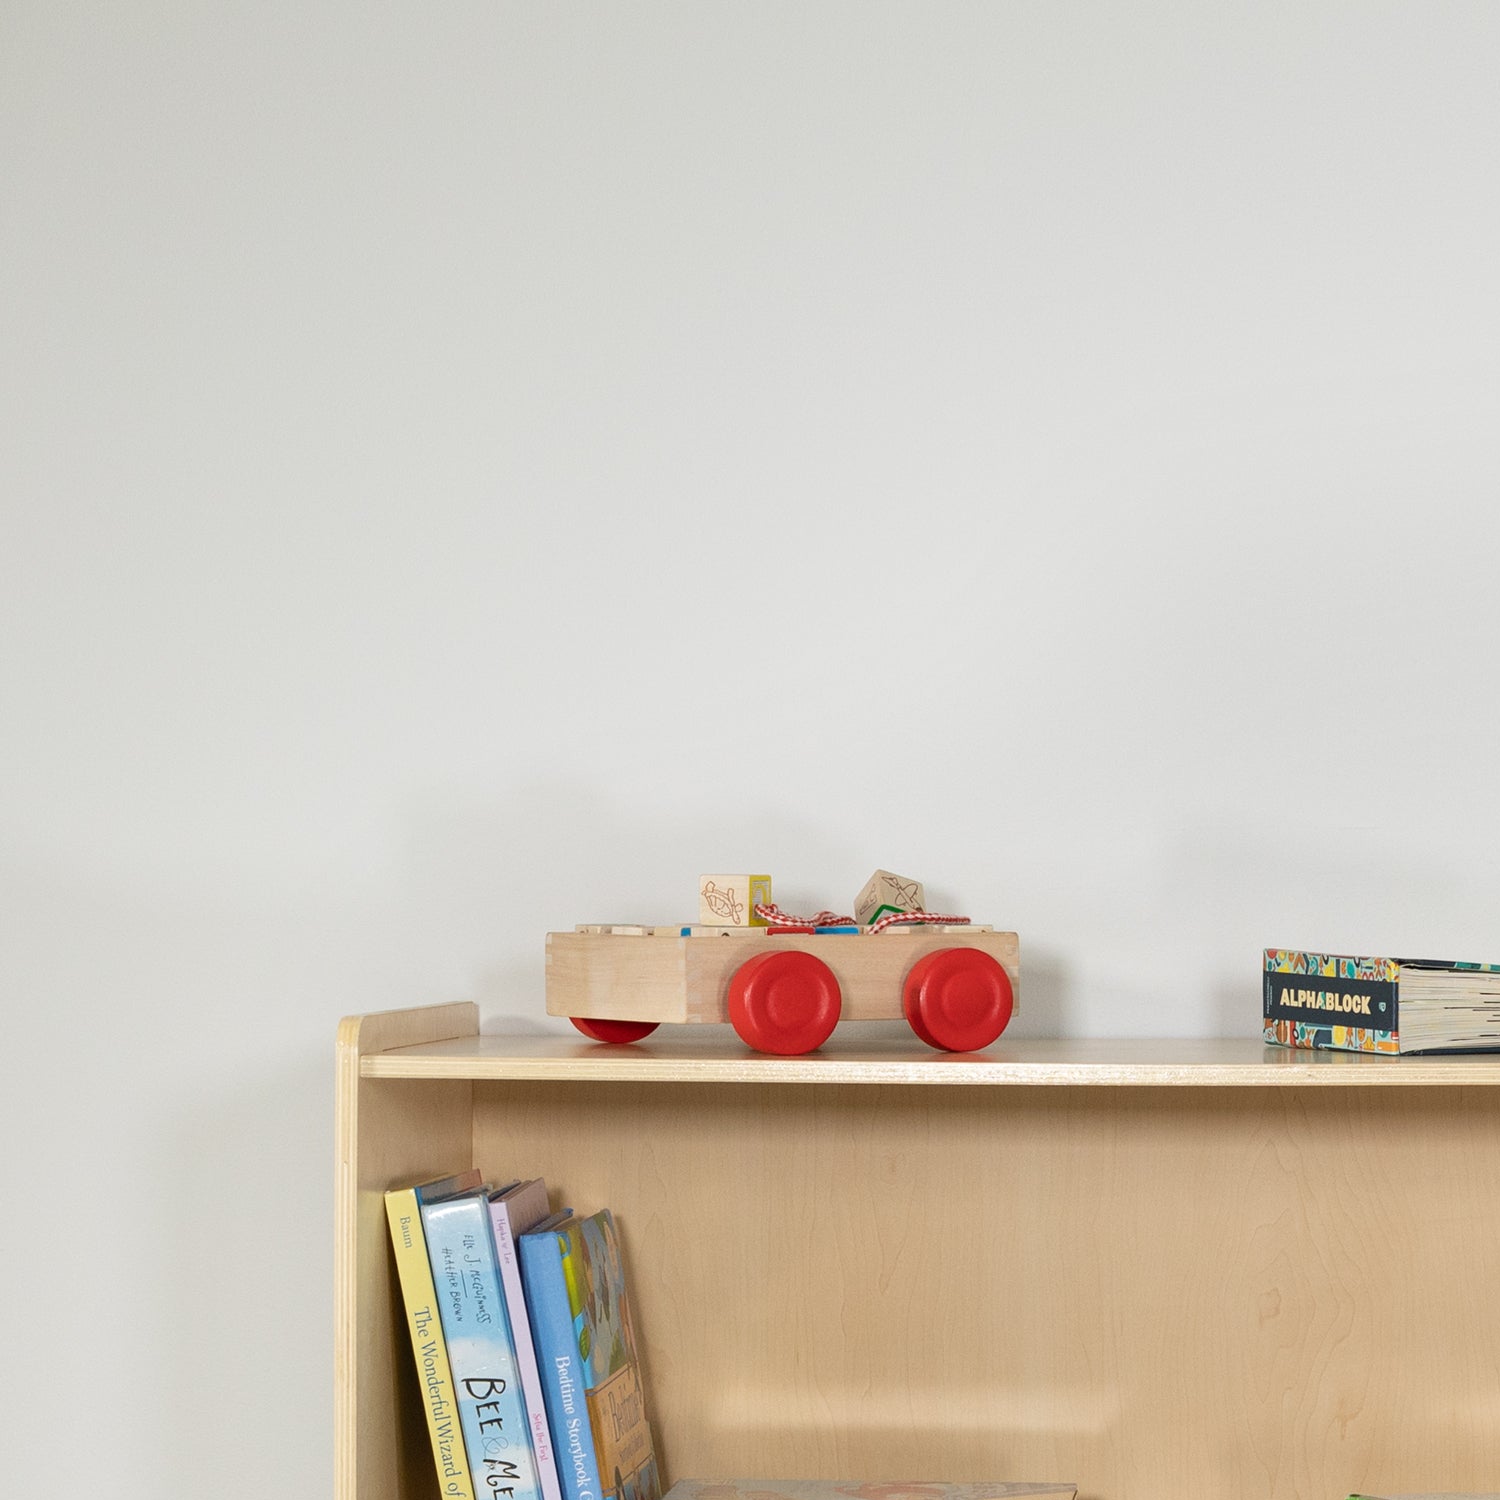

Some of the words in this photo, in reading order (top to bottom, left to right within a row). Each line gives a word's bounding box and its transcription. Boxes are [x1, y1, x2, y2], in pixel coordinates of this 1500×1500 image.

[1280, 988, 1371, 1015] ALPHABLOCK
[400, 1216, 412, 1248] Baum
[414, 1306, 432, 1338] The
[450, 1291, 463, 1322] BROWN
[421, 1341, 452, 1422] Wonderful
[462, 1378, 506, 1435] BEE
[555, 1355, 575, 1414] Bedtime
[566, 1418, 591, 1488] Storybook
[437, 1423, 462, 1478] Wizard
[481, 1436, 509, 1456] &
[445, 1484, 466, 1498] of
